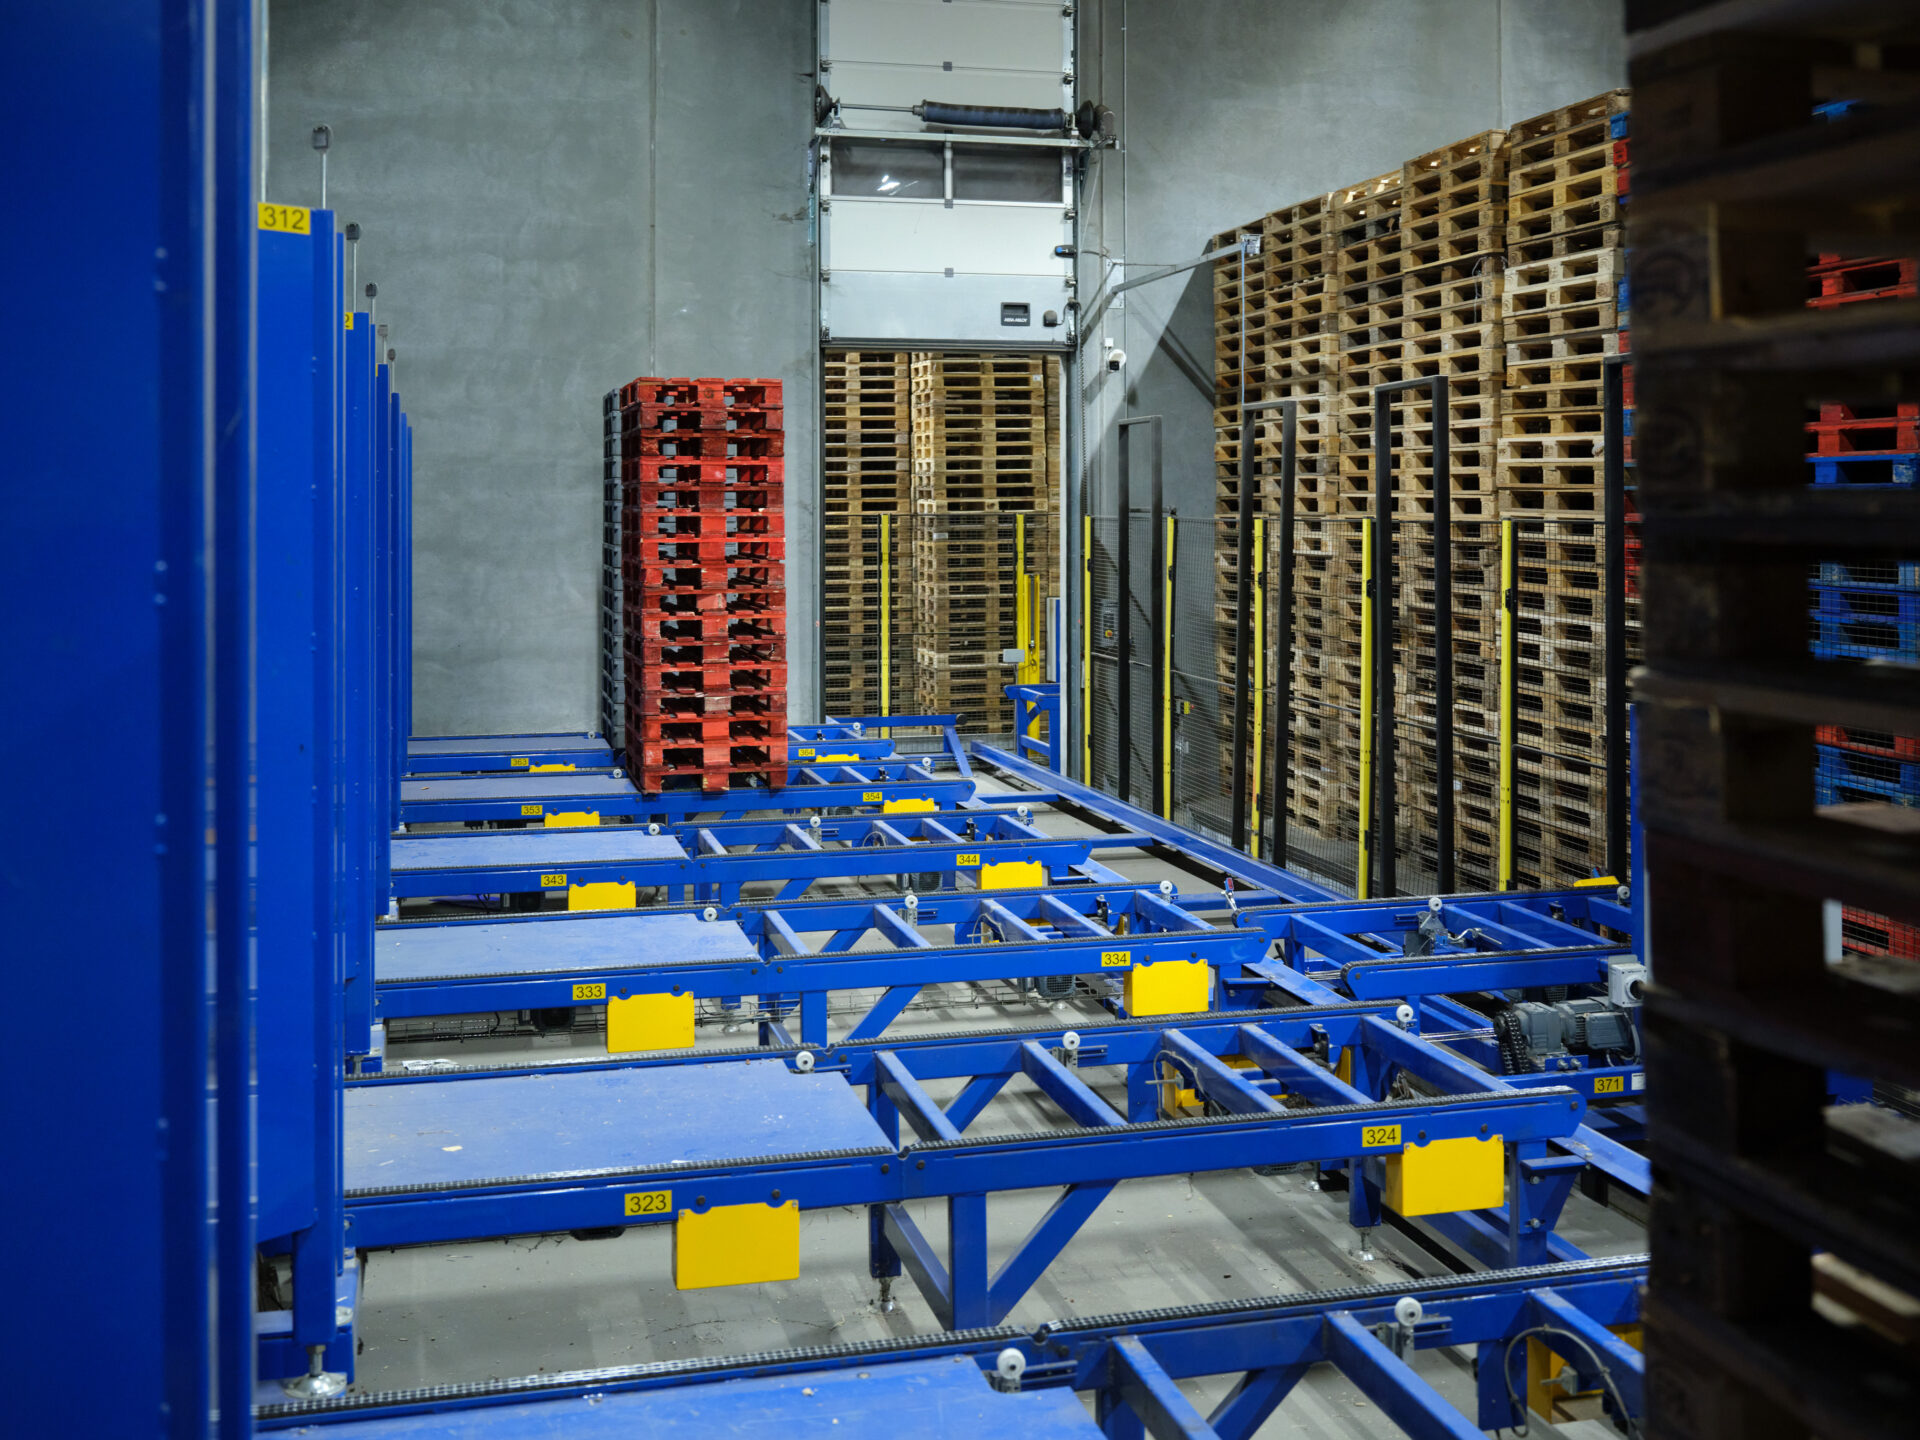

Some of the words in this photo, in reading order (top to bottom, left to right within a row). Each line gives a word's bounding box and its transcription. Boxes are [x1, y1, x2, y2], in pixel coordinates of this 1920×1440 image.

[263, 206, 304, 230] 312
[513, 758, 527, 766] 363
[864, 792, 880, 801] 354
[523, 805, 541, 814] 353
[958, 855, 978, 864] 344
[543, 875, 565, 886] 343
[1104, 953, 1128, 965] 334
[576, 985, 602, 999] 333
[1597, 1078, 1620, 1092] 371
[1366, 1127, 1397, 1145] 324
[630, 1193, 667, 1213] 323
